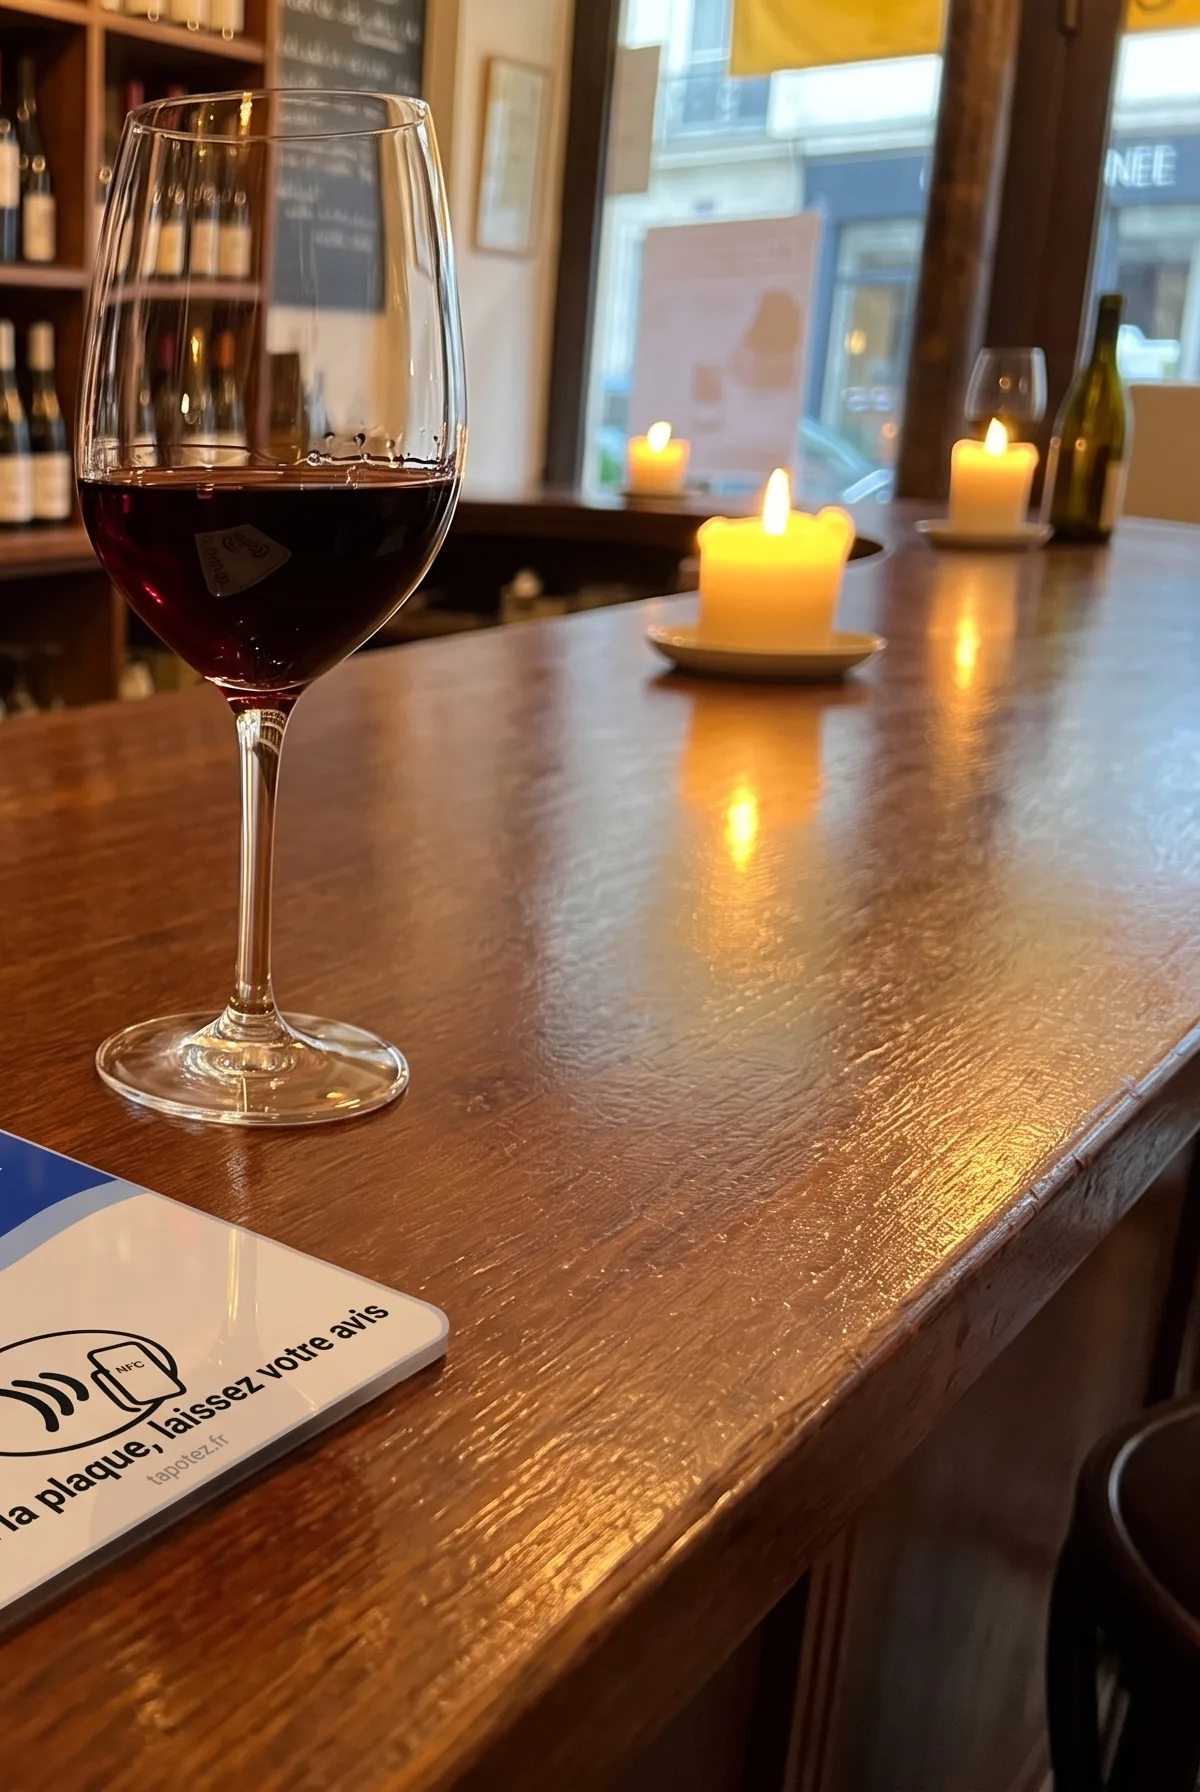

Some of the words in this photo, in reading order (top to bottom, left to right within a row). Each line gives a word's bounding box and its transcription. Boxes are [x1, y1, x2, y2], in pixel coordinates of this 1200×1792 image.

[115, 1360, 145, 1374] NFC
[34, 1440, 165, 1516] plaque,
[146, 1376, 266, 1440] laissez
[255, 1337, 334, 1380] votre
[329, 1303, 389, 1339] avis
[146, 1432, 230, 1487] tapotez.fr
